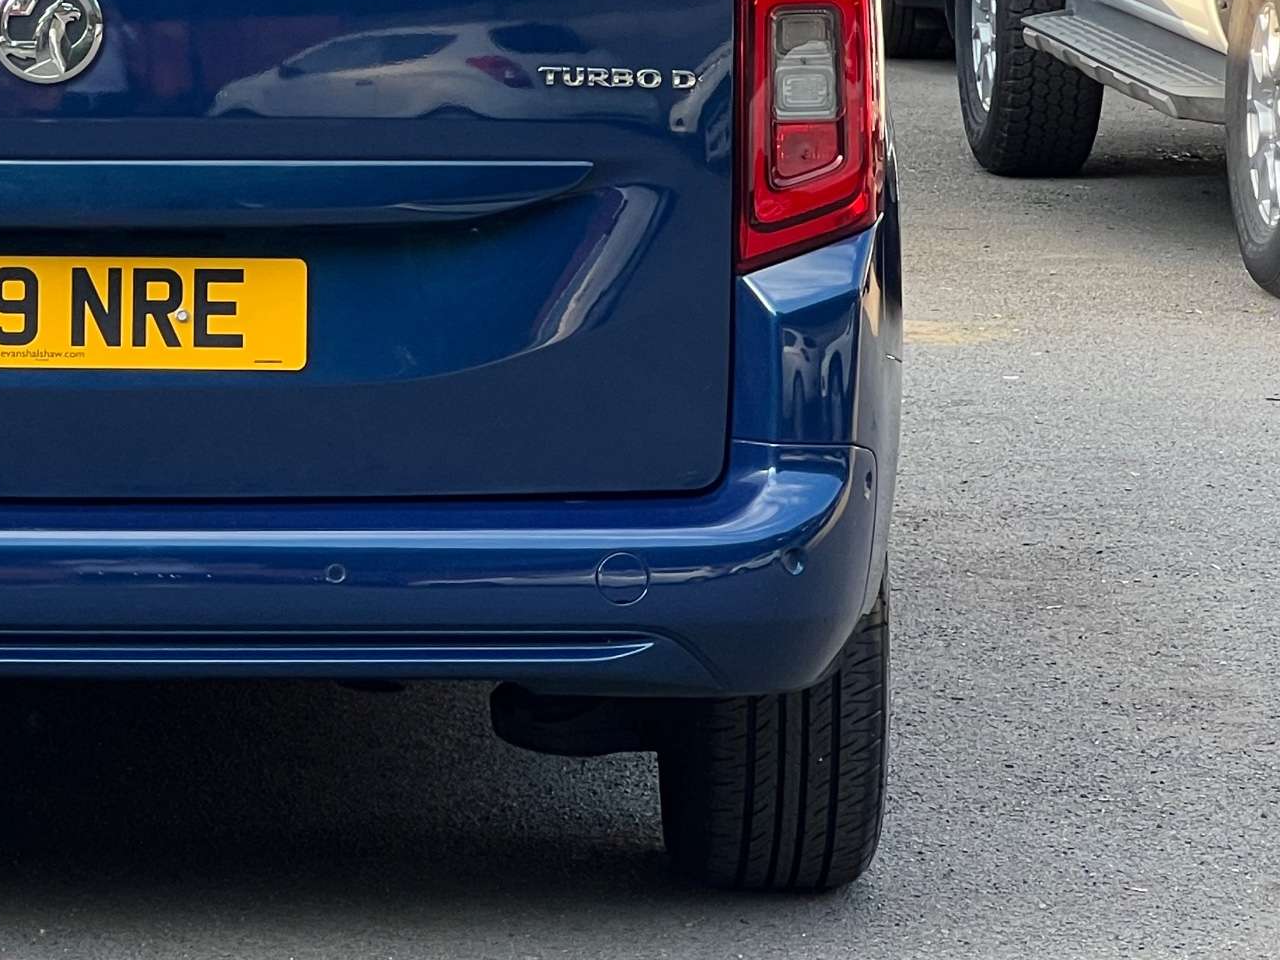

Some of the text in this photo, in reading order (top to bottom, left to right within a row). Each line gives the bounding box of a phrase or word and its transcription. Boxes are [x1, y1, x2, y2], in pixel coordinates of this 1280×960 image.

[538, 67, 696, 88] TURBO D
[70, 268, 245, 348] NRE
[0, 349, 85, 359] evanshalshaw.com
